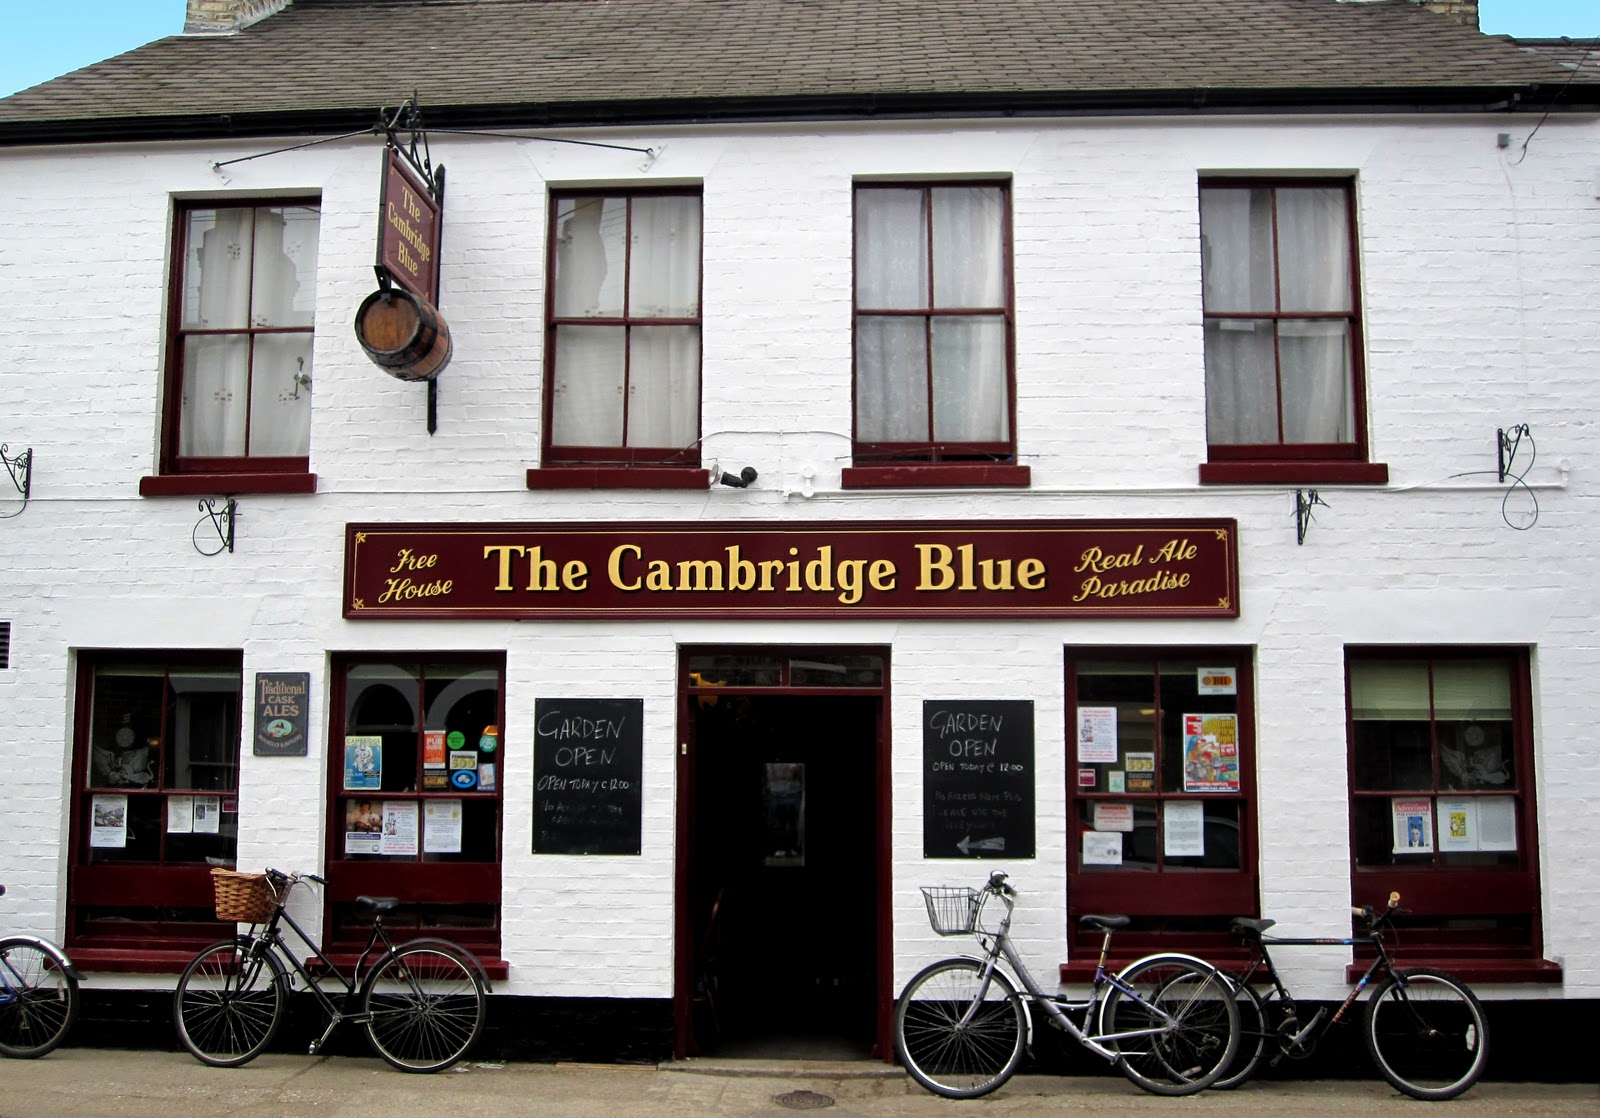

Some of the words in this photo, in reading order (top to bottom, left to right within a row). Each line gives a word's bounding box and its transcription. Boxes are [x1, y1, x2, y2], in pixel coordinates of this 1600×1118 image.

[401, 187, 421, 223] The
[388, 202, 431, 262] Cambridge
[398, 240, 418, 277] Blue
[390, 548, 438, 573] Free
[1073, 544, 1145, 573] Real
[1149, 538, 1198, 564] Ale
[483, 544, 588, 592] The
[607, 543, 897, 605] Cambridge
[914, 543, 1046, 591] Blue
[1072, 569, 1192, 602] Paradise
[378, 578, 453, 604] House
[258, 679, 305, 704] Traditional
[268, 695, 296, 704] CASK
[262, 704, 300, 717] ALES
[537, 710, 626, 740] GARDEN
[930, 710, 1003, 739] GARDEN
[555, 746, 617, 767] OPEN
[949, 738, 998, 757] OPEN
[932, 762, 955, 772] OPEN
[959, 763, 985, 774] TODAY
[537, 775, 567, 792] OPEN
[569, 778, 600, 794] TODAY
